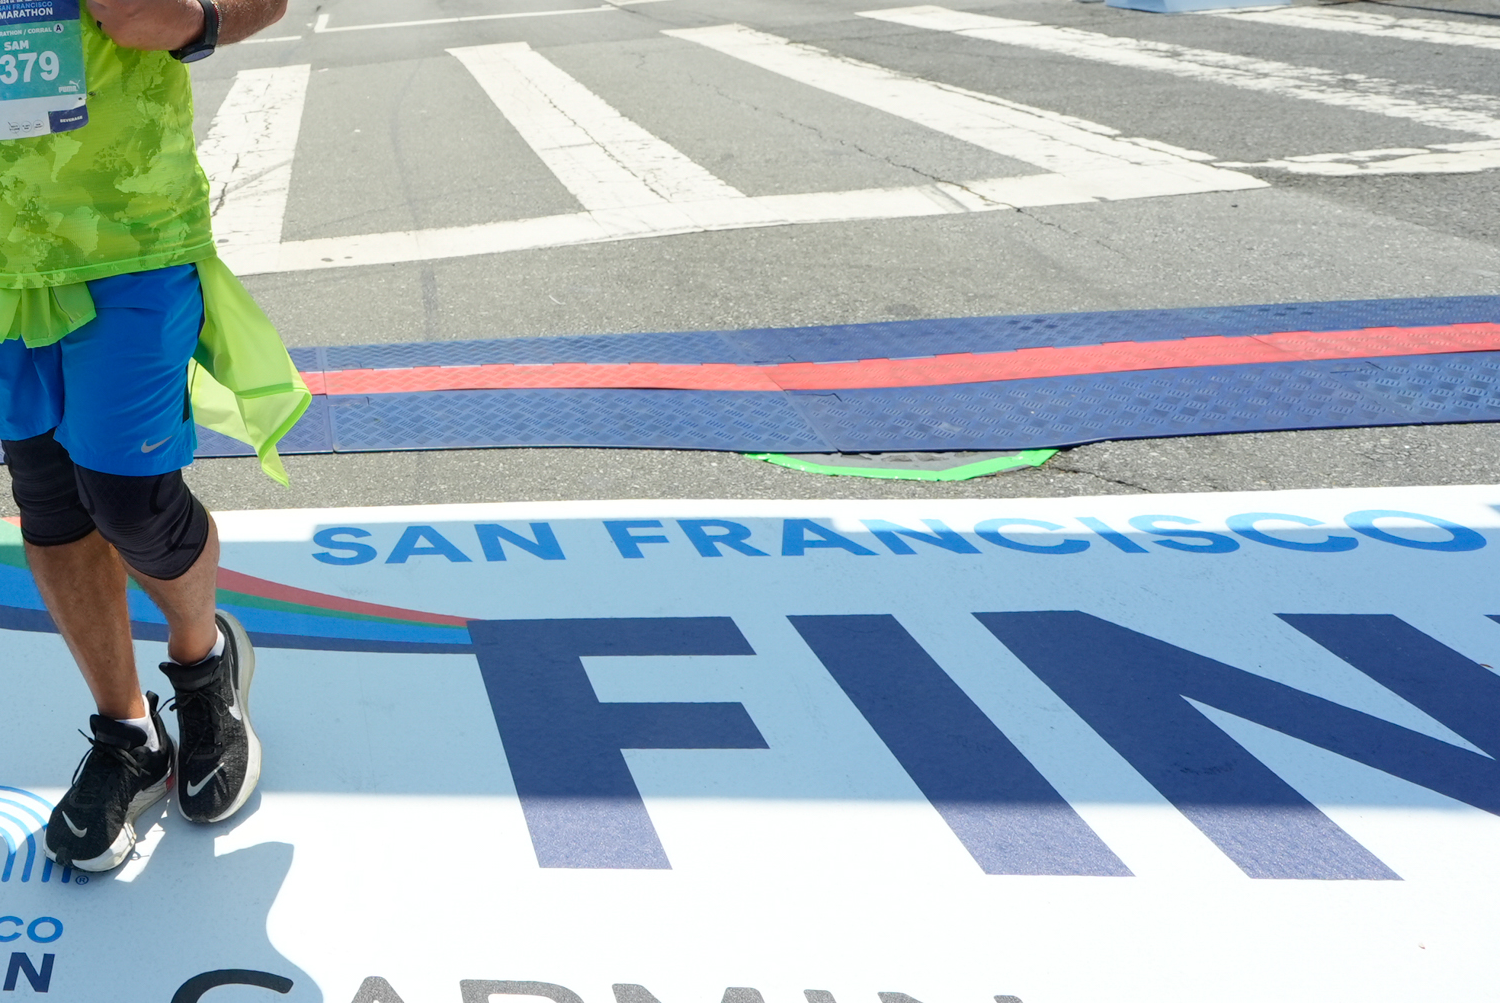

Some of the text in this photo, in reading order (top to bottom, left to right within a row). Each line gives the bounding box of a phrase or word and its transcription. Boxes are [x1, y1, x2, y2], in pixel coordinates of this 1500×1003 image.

[13, 1, 53, 9] FRANCISCO
[3, 40, 29, 51] SAM
[311, 509, 1487, 566] SAN FRANCISCO
[466, 609, 1500, 882] FIN
